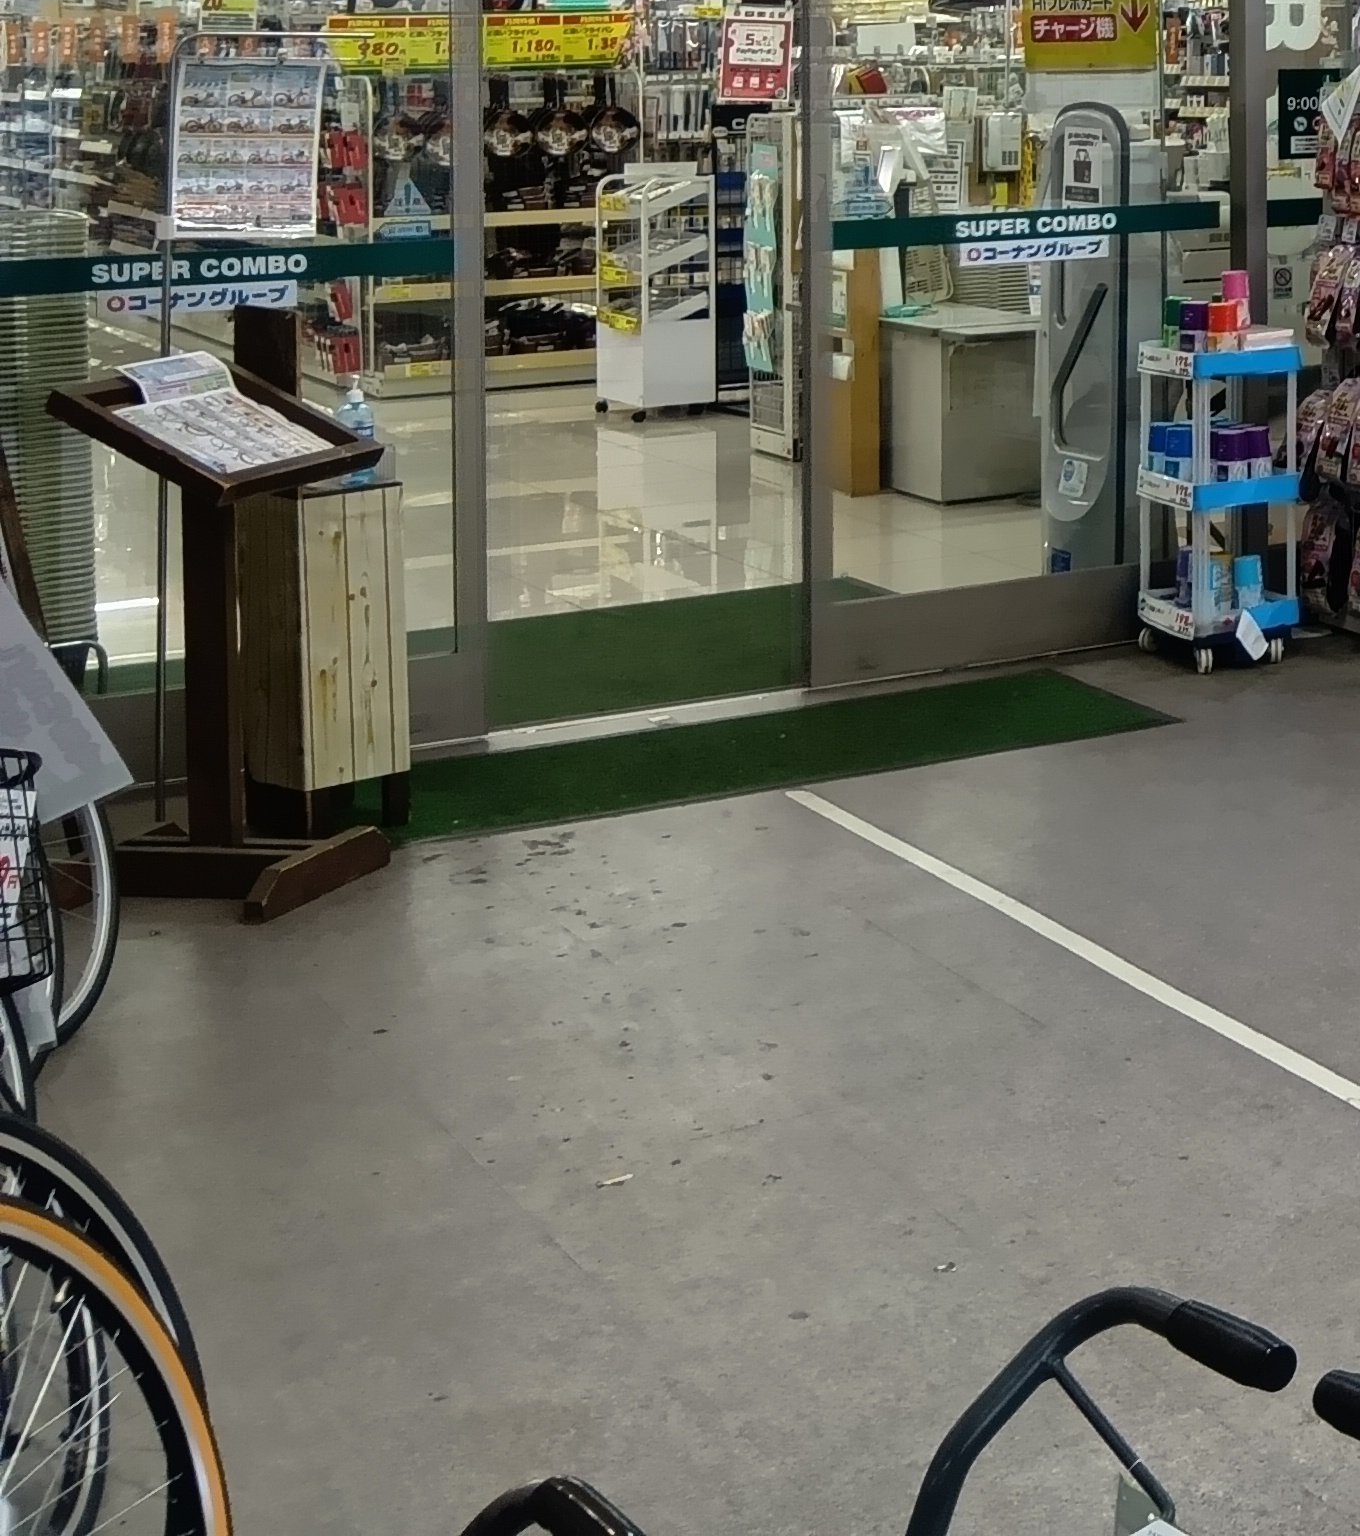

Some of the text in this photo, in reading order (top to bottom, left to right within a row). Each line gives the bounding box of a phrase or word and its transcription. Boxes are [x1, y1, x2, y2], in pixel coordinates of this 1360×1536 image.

[1034, 17, 1115, 39] チャージ機
[956, 212, 1117, 238] SUPER COMBO
[983, 239, 1103, 260] コーナングループ
[91, 253, 308, 284] SUPER COMBO
[127, 284, 290, 310] コーナングループ
